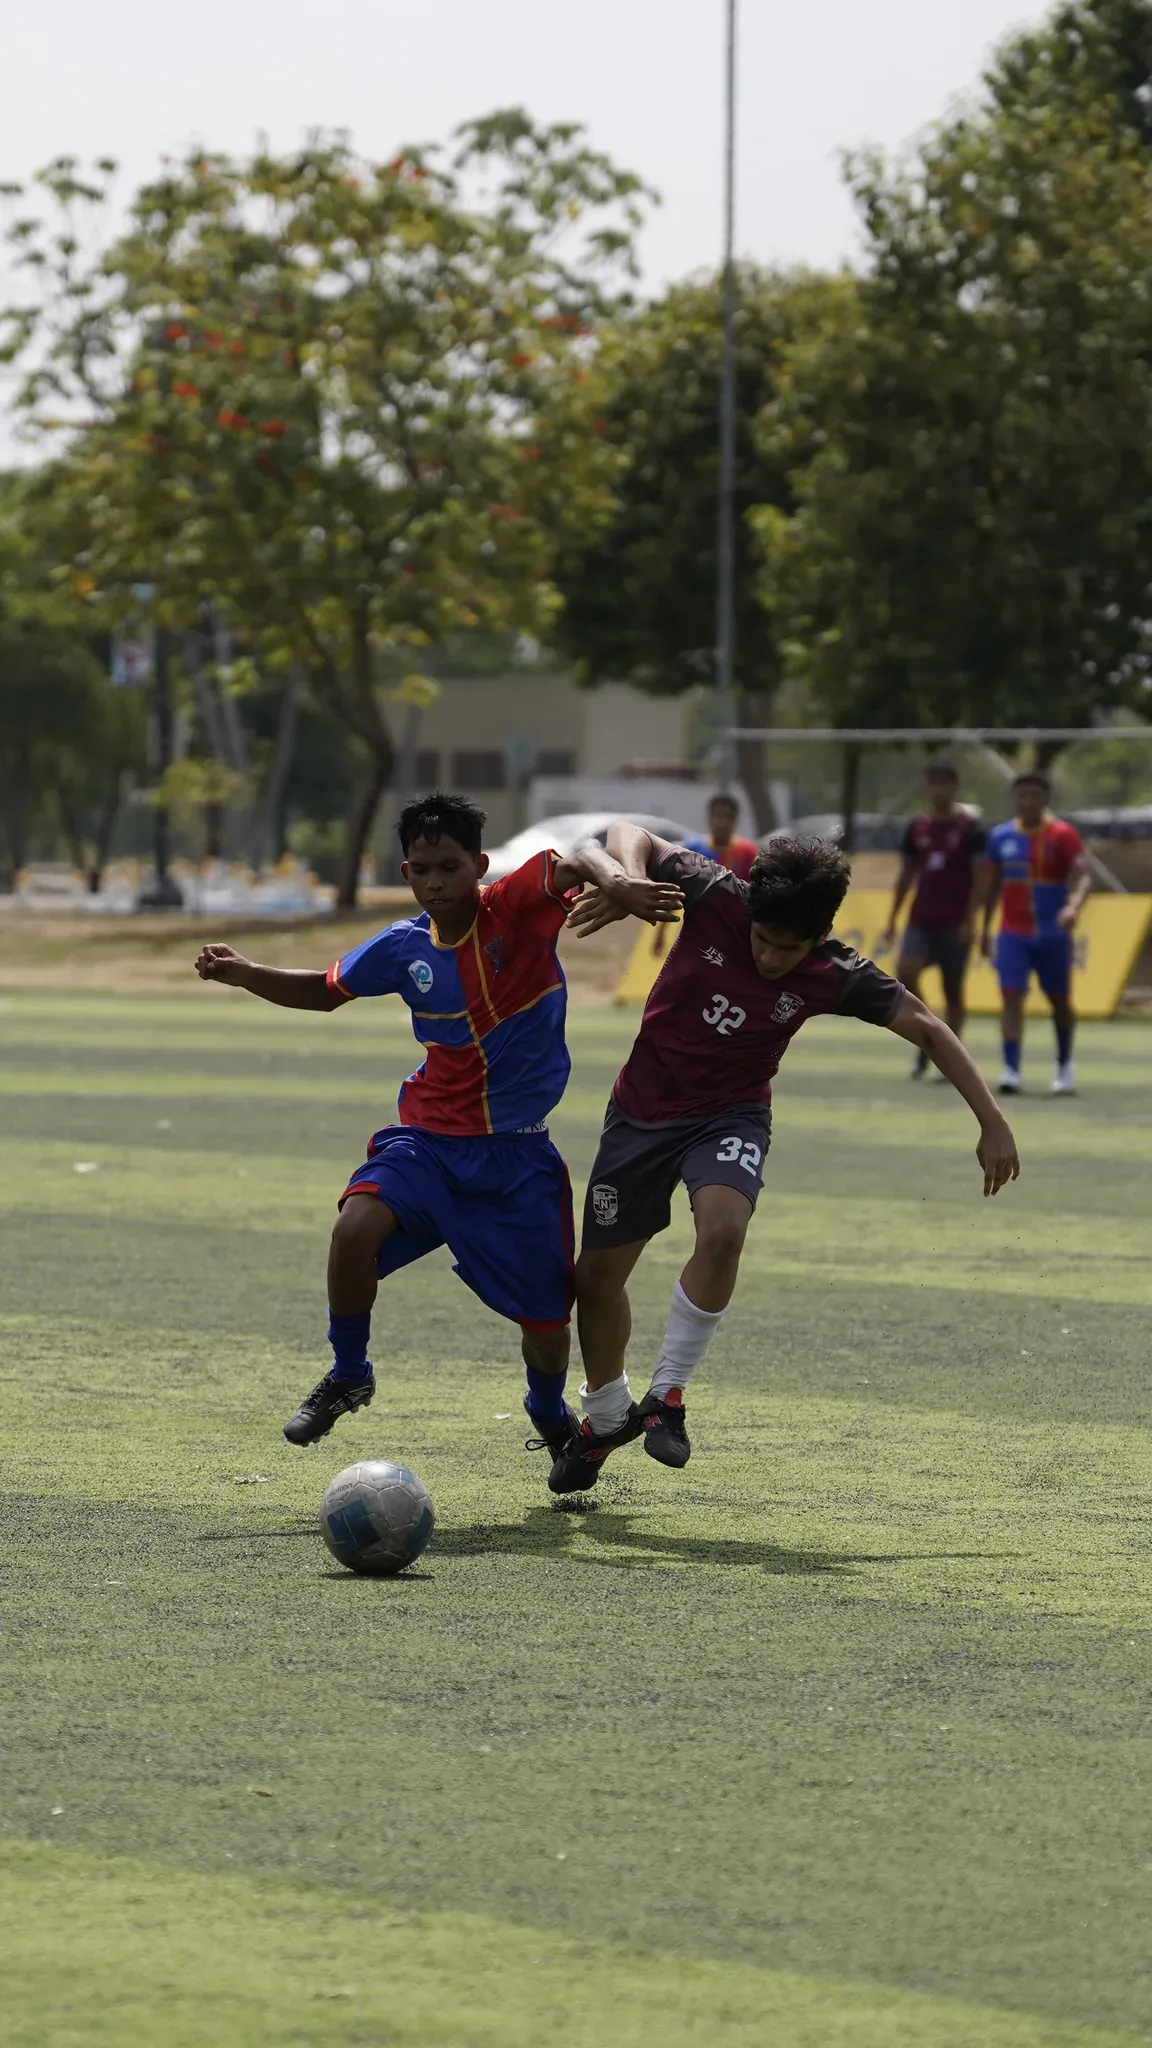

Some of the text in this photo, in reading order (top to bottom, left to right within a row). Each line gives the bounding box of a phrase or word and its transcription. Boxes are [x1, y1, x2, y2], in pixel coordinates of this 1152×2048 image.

[702, 994, 747, 1036] 32
[782, 1002, 792, 1012] N
[716, 1136, 761, 1177] 32
[600, 1199, 609, 1210] N
